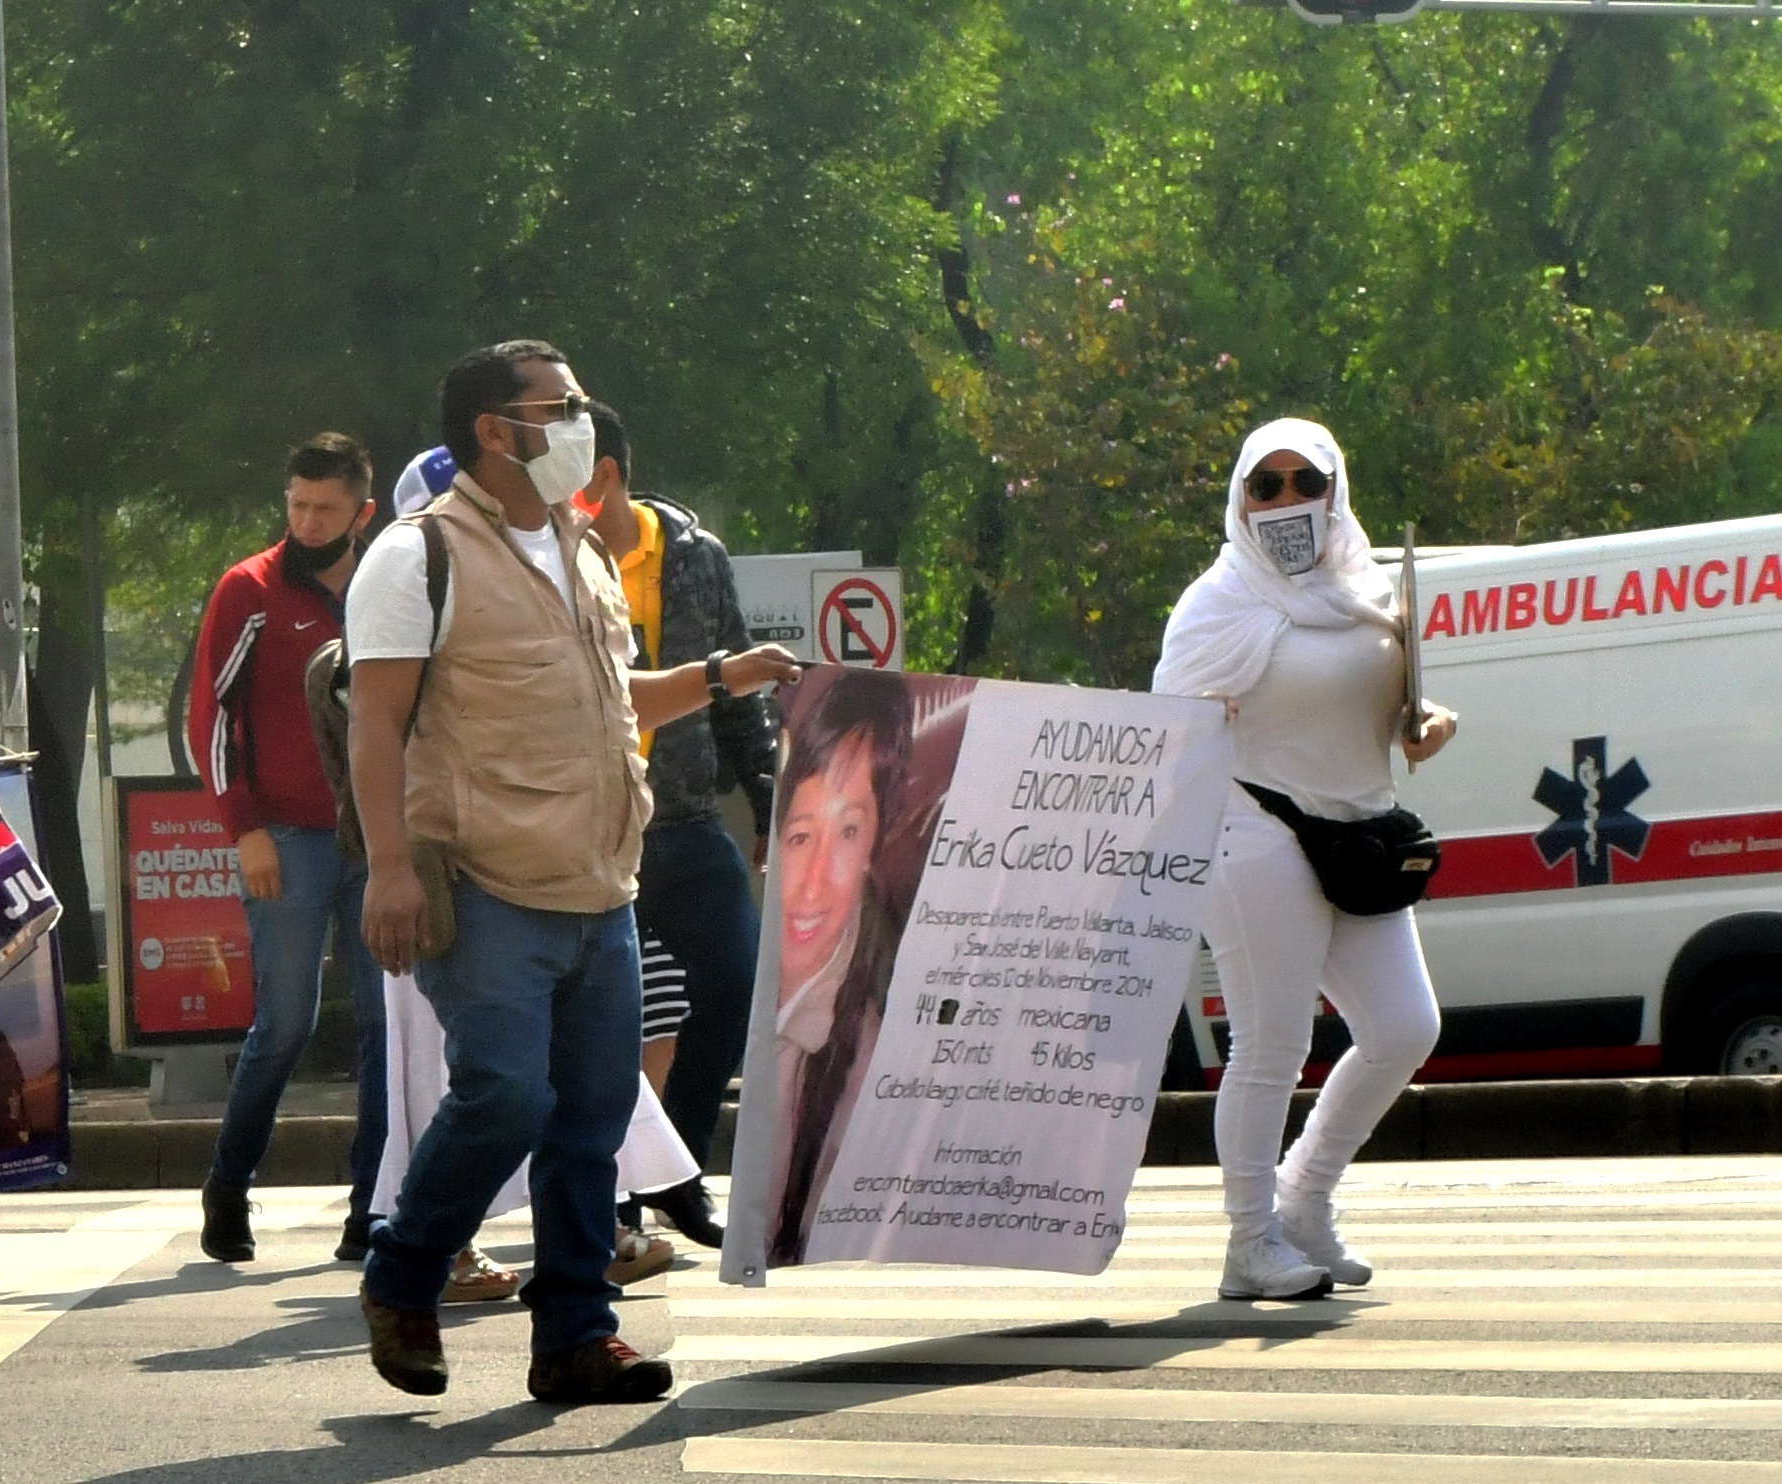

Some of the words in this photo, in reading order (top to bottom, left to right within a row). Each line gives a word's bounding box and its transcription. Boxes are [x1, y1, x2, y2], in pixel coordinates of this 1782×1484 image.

[1423, 553, 1782, 642] AMBULANCIA
[1031, 717, 1149, 766] AYUDANOS
[1011, 770, 1133, 816] ENCONTRAR
[1137, 778, 1155, 817] A
[151, 820, 185, 835] Salva
[189, 819, 224, 834] Vidas
[136, 843, 240, 873] QUÉDATE
[931, 819, 995, 869] Erika
[1000, 824, 1074, 872] Cueto
[1084, 832, 1211, 896] Vázquez
[137, 874, 170, 900] EN
[174, 873, 242, 899] CASA
[1140, 915, 1193, 941] Jalisco
[960, 1001, 1002, 1027] años
[1017, 1003, 1111, 1034] mexicana
[1058, 1083, 1084, 1107] de
[1087, 1091, 1145, 1119] negro
[1073, 1218, 1087, 1235] a
